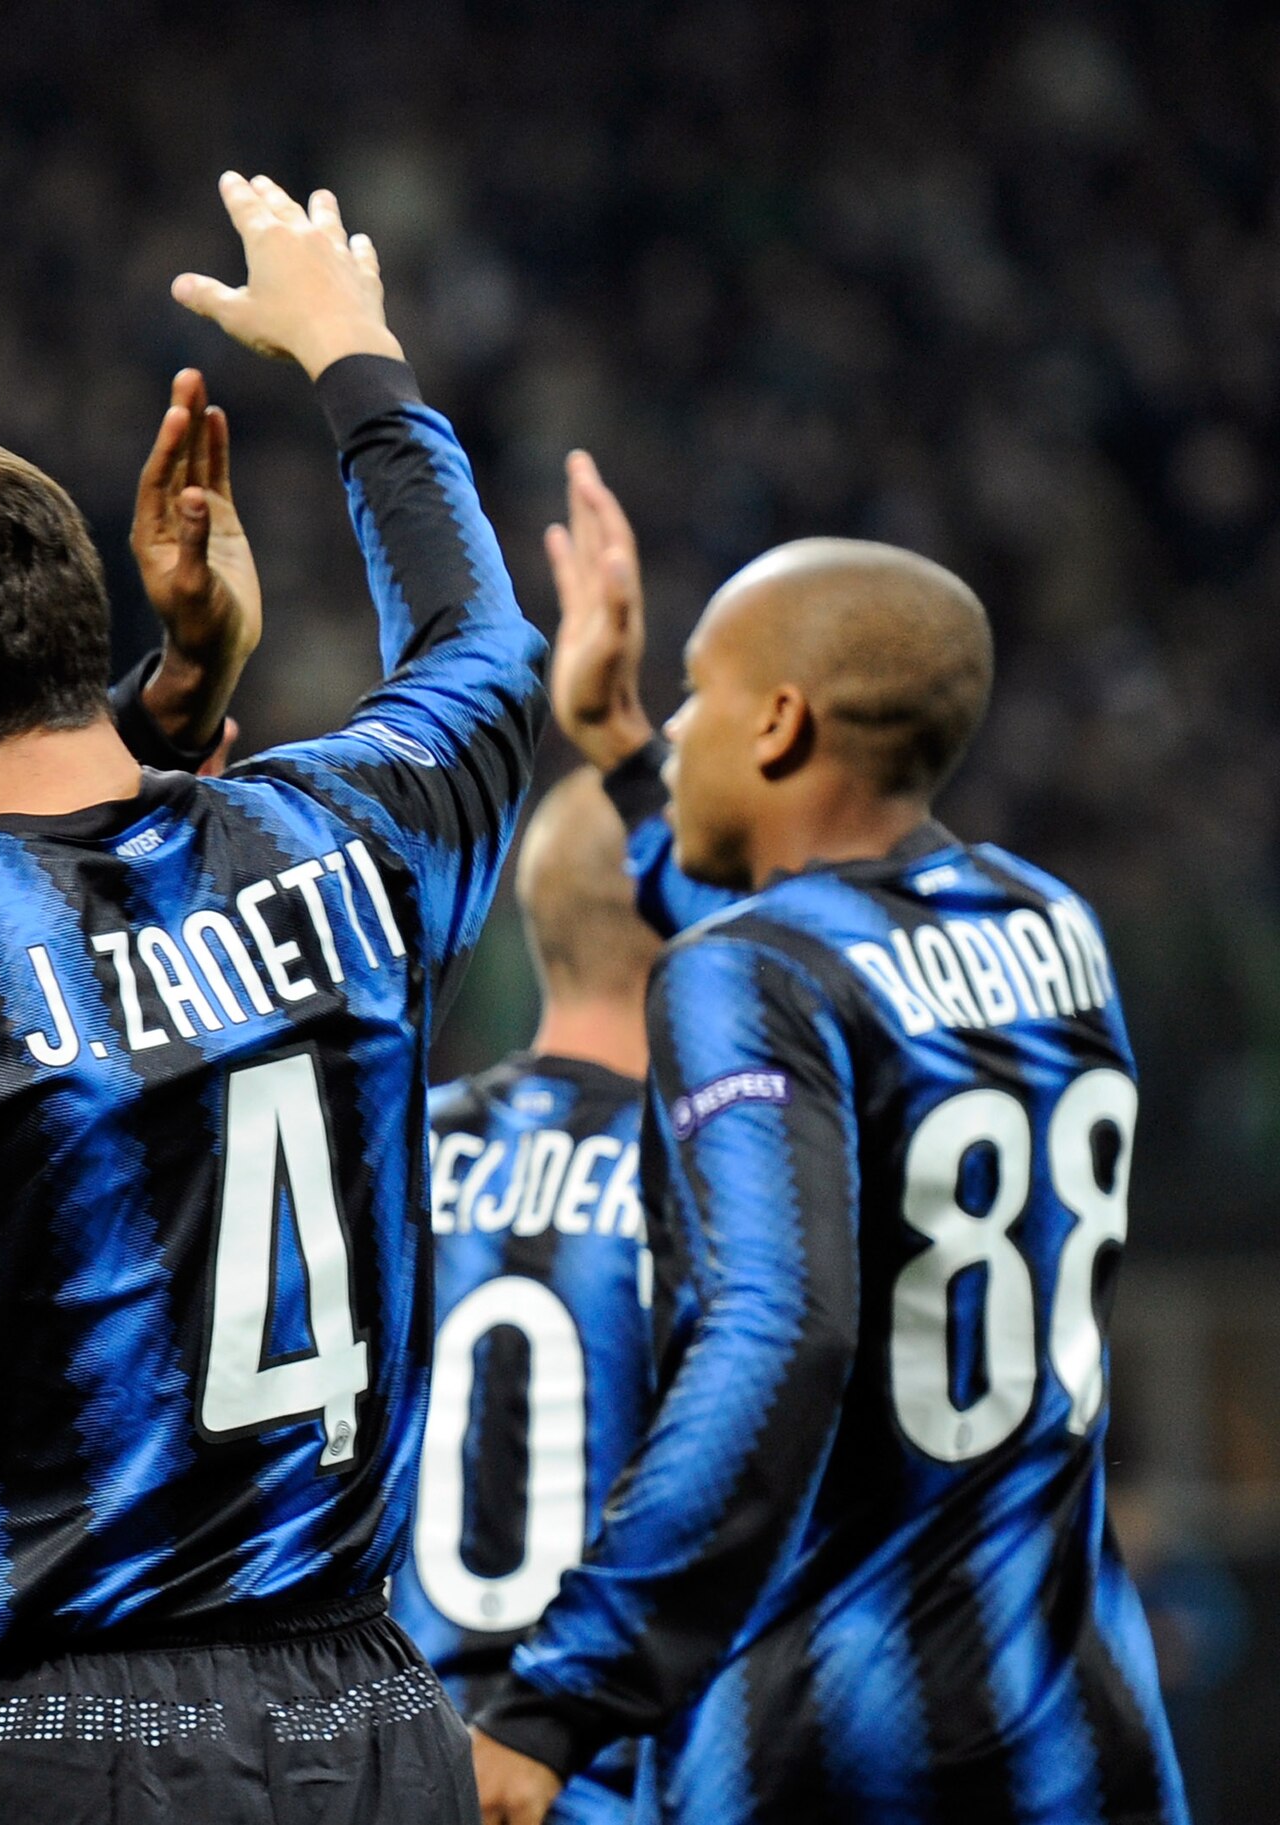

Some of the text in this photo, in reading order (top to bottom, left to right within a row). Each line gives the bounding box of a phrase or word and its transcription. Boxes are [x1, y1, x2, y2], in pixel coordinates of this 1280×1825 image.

[692, 1072, 786, 1118] RESPECT
[845, 895, 1113, 1037] BIABIAN
[202, 1053, 368, 1467] 4
[890, 1067, 1138, 1462] 88
